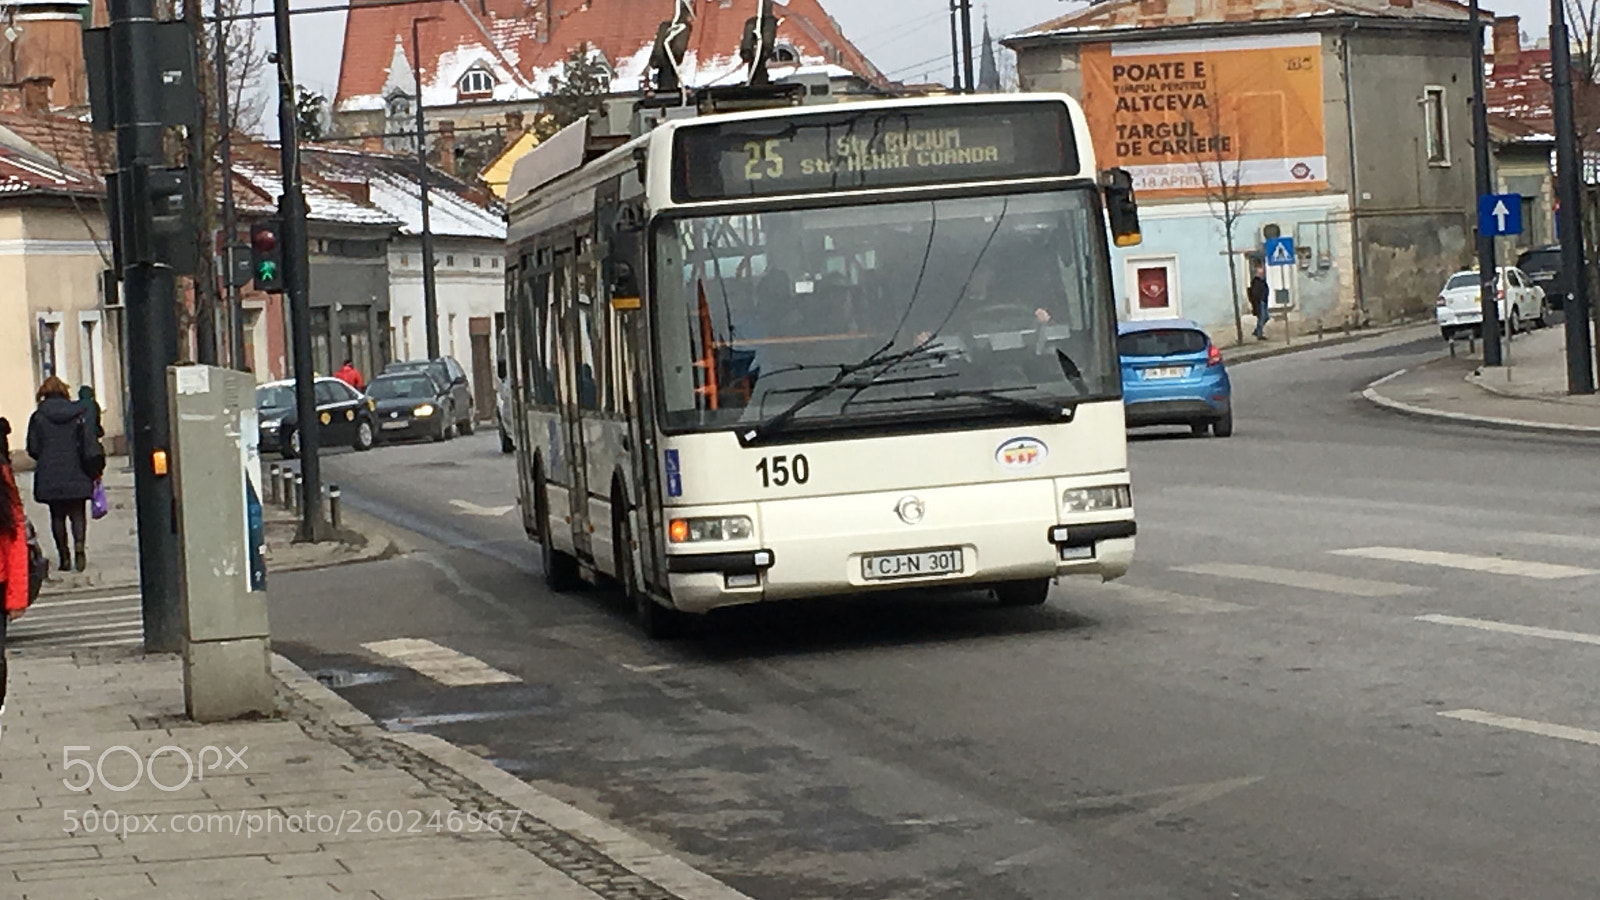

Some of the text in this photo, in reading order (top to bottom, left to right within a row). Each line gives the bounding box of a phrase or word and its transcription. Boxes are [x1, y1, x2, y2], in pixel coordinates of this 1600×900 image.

[1112, 61, 1206, 82] POATE E
[1116, 93, 1208, 113] ALTCEVA
[837, 127, 962, 157] Str. BUCIUM
[1115, 122, 1199, 139] TARGUL
[743, 139, 784, 180] 25
[847, 149, 911, 172] HENRI
[916, 145, 999, 167] COANDA
[1116, 141, 1142, 157] DE
[756, 453, 809, 487] 150
[879, 551, 955, 574] CJ-N 301
